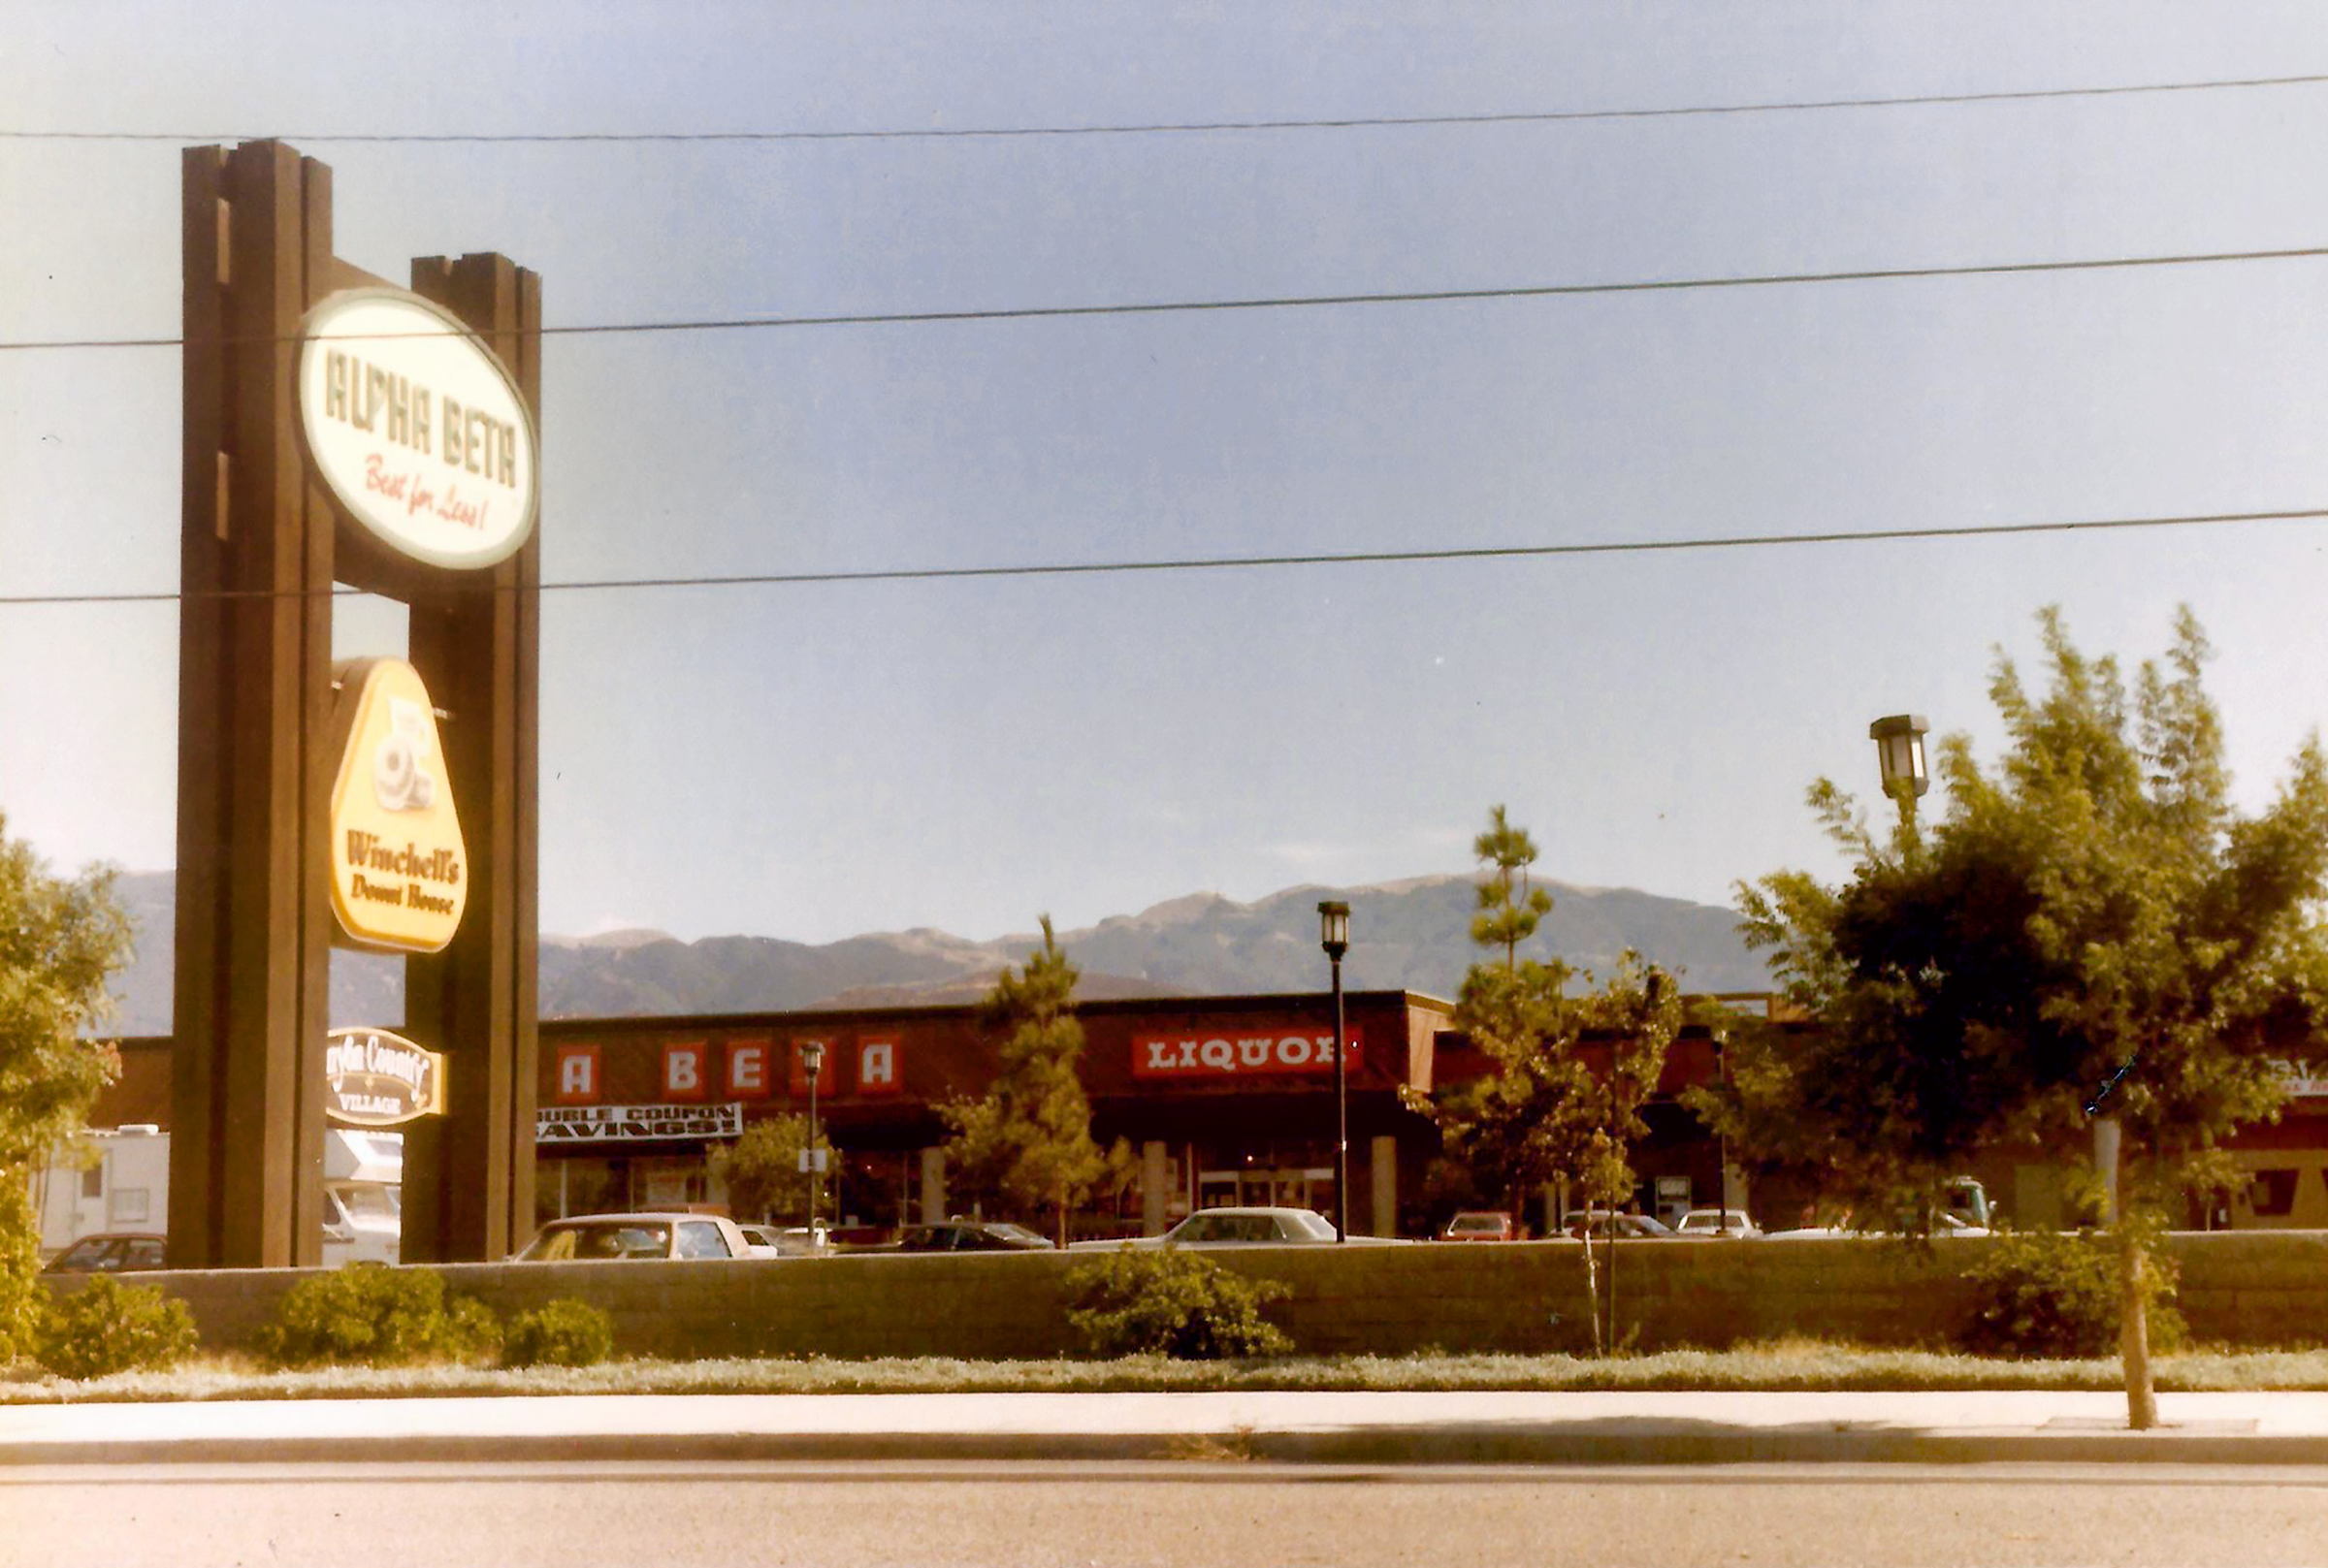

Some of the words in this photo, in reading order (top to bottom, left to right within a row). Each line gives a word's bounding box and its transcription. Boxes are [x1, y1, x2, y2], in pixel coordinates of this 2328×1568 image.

[325, 346, 432, 456] ALPHA
[442, 396, 516, 489] BETA
[364, 454, 409, 501] Best
[347, 829, 459, 885] Winchell's
[407, 884, 455, 915] House
[667, 1043, 893, 1091] BEA
[339, 1093, 401, 1115] VILLAGE
[627, 1106, 735, 1121] COUPON
